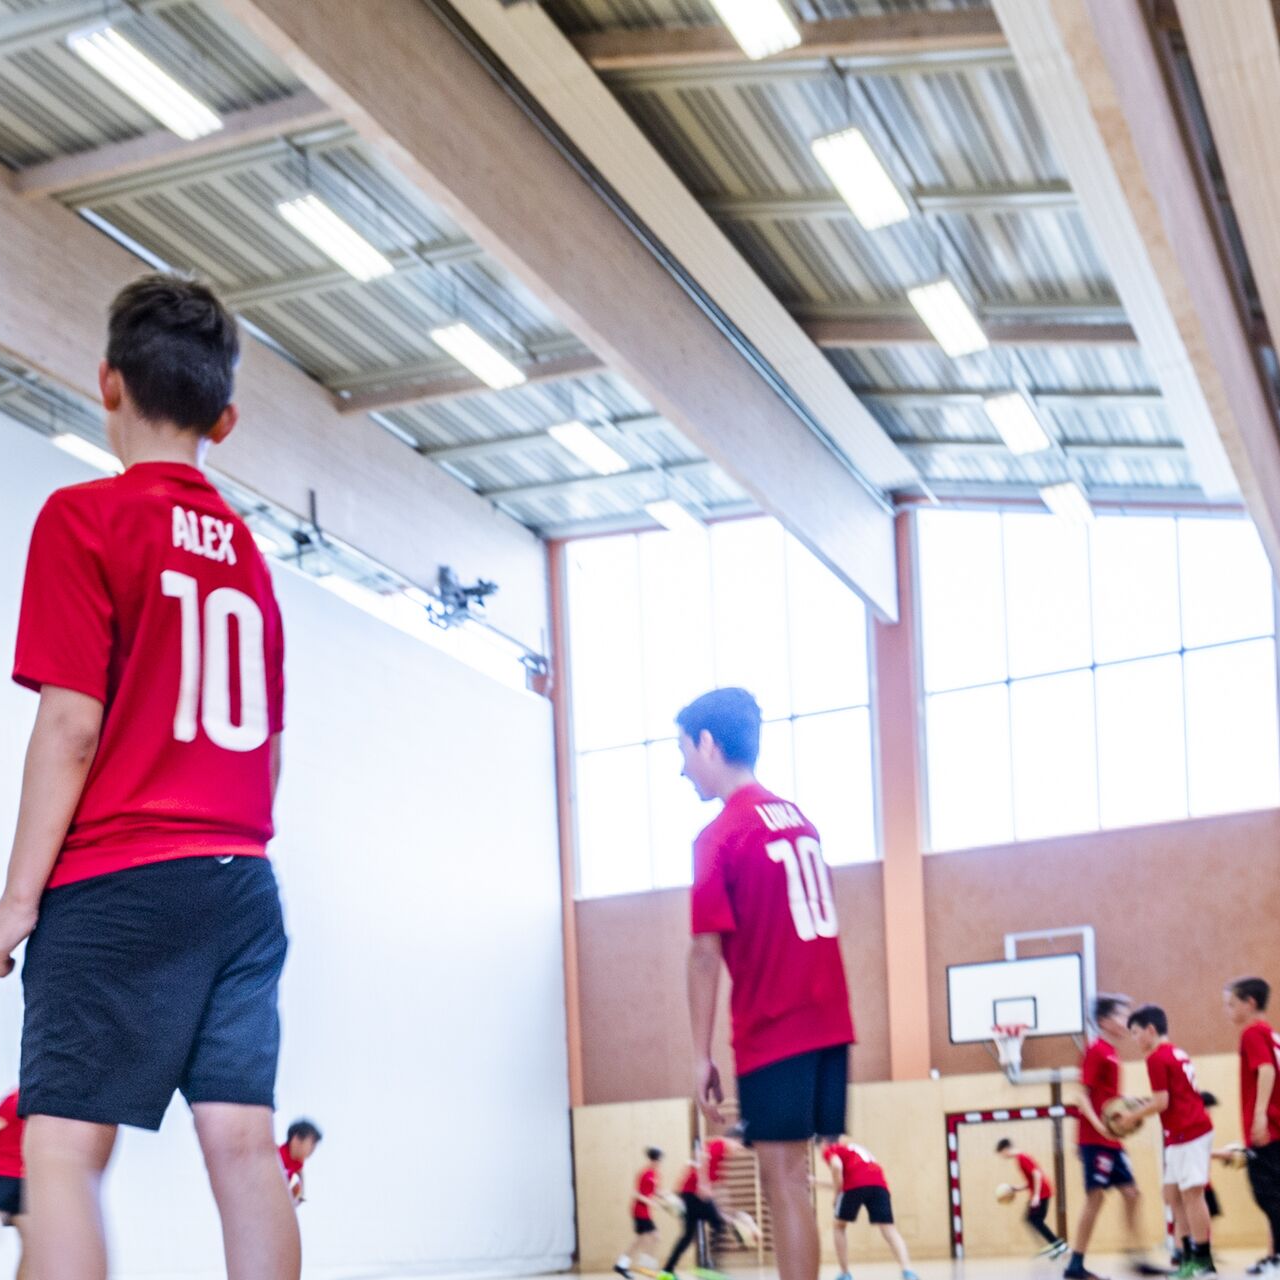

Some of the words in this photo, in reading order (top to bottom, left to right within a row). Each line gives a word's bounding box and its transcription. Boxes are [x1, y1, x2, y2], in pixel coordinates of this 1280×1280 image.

[172, 505, 237, 565] ALEX
[160, 569, 269, 752] 10
[765, 835, 838, 942] 10
